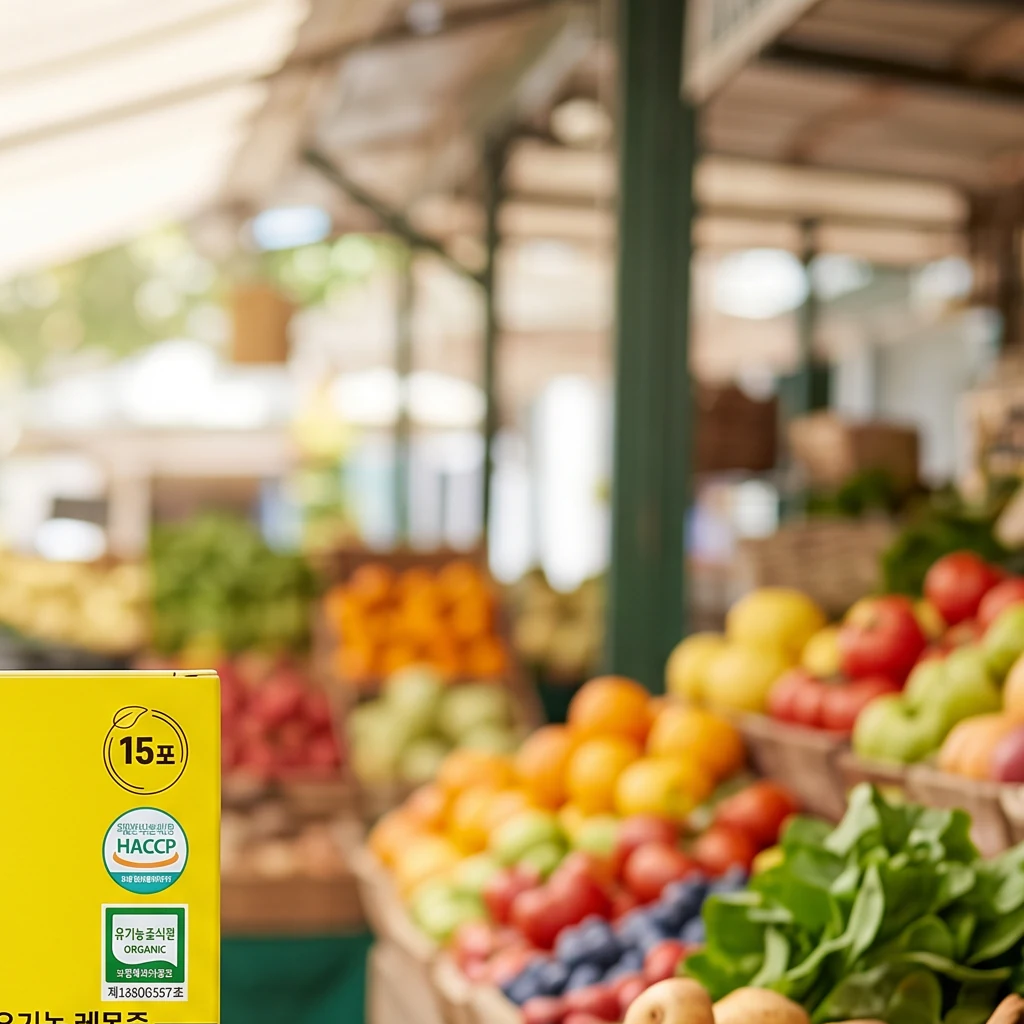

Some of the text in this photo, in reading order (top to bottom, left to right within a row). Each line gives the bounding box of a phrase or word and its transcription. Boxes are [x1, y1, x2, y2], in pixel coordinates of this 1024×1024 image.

[119, 736, 175, 764] 15포
[117, 838, 177, 854] HACCP
[124, 945, 166, 954] ORGANIC
